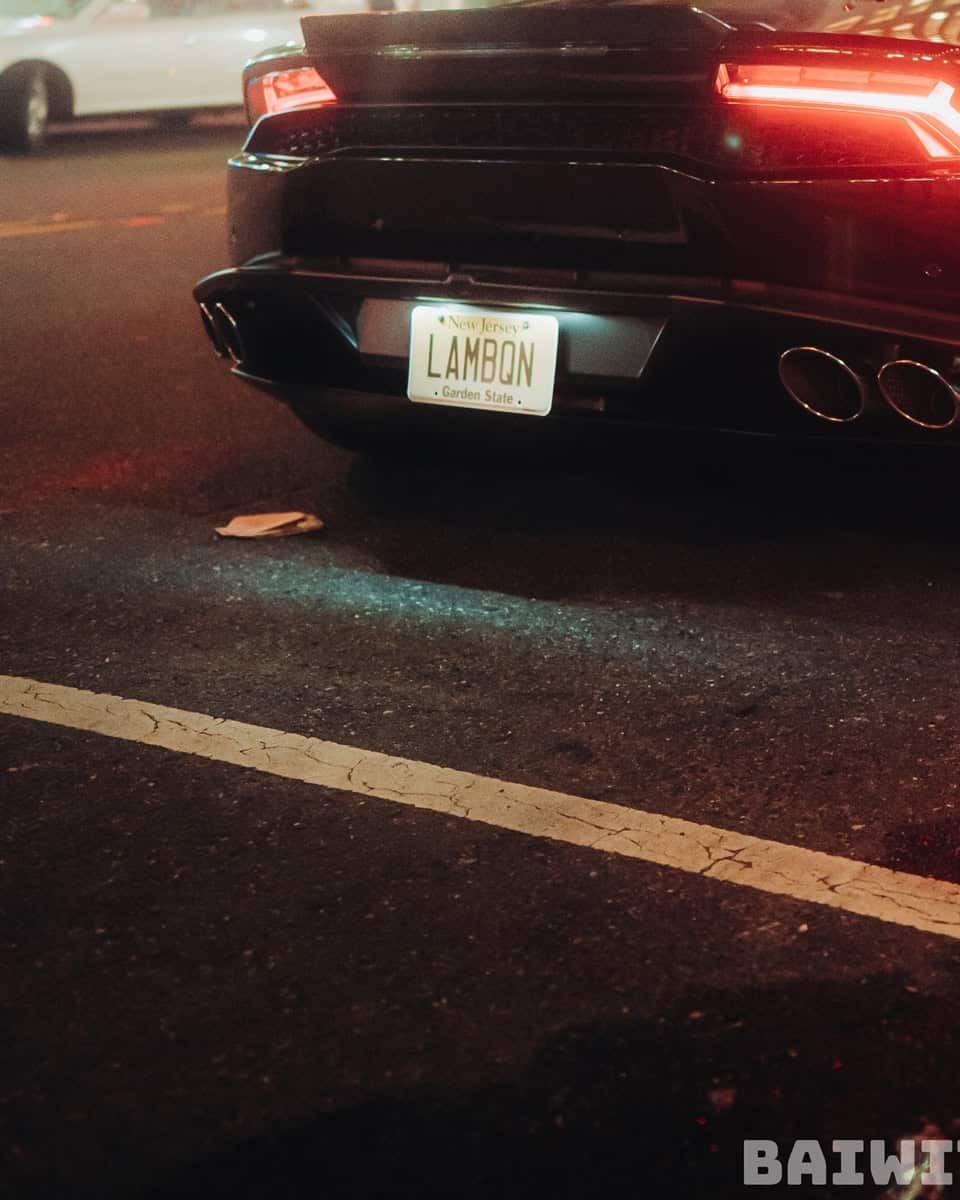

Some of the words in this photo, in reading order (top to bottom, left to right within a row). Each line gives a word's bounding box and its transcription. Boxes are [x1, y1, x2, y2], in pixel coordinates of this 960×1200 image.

[448, 315, 476, 330] New
[480, 317, 520, 335] Jersey
[427, 333, 535, 388] LAMBQN
[441, 385, 481, 401] Garden
[484, 389, 514, 405] State
